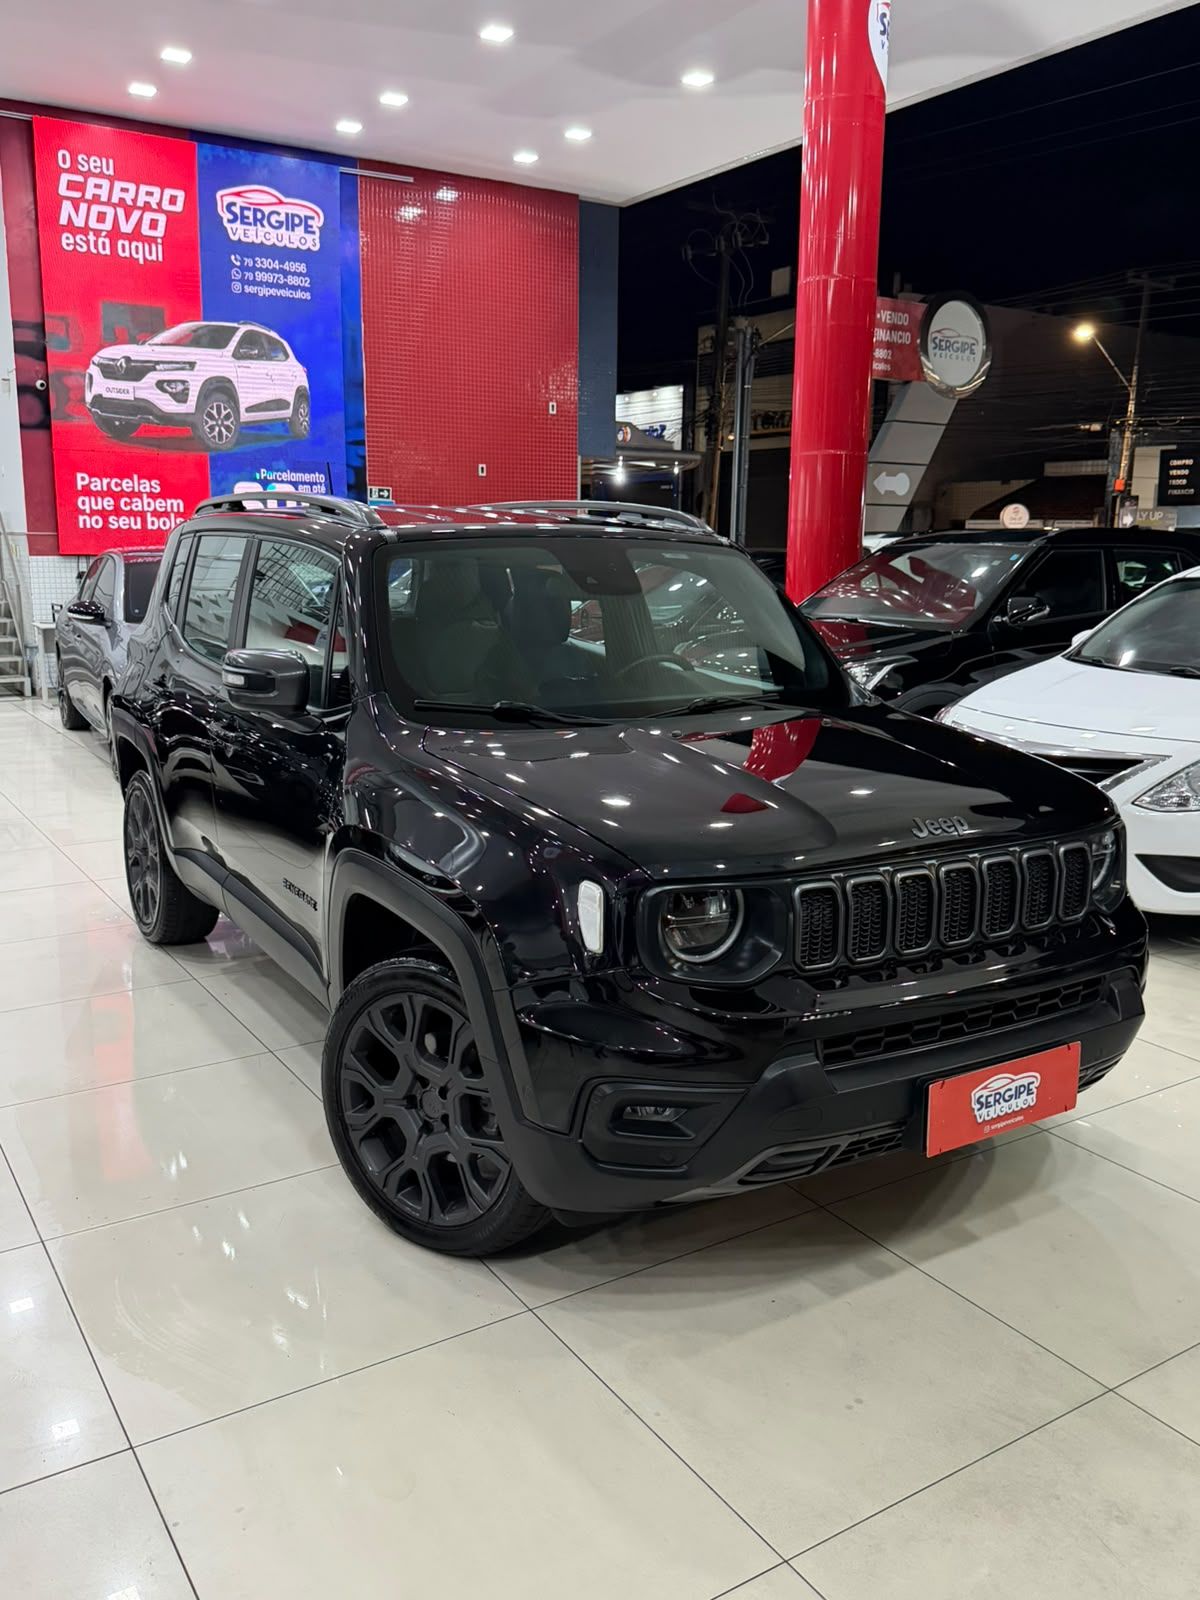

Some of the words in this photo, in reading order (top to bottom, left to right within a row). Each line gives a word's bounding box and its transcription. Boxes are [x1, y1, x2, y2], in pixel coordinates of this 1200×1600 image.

[77, 153, 115, 177] seu
[58, 172, 186, 213] CARRO
[59, 199, 168, 238] NOVO
[225, 201, 316, 235] SERGIPE
[230, 226, 317, 247] VEÍCULOS
[61, 230, 111, 256] está
[117, 238, 164, 265] aqui
[243, 257, 254, 268] 79
[255, 257, 307, 273] 3304-4956
[244, 271, 254, 281] 79
[255, 271, 310, 287] 99973-8802
[244, 285, 311, 300] sergipeveiculos
[881, 310, 909, 326] VENDO
[932, 337, 976, 355] SERGIPE
[76, 471, 161, 494] Parcelas
[260, 468, 326, 484] Parcelamento
[297, 484, 311, 493] em
[312, 483, 327, 495] até
[77, 494, 115, 514] que
[119, 493, 185, 514] cabem
[78, 514, 104, 530] no
[108, 515, 142, 531] seu
[146, 512, 190, 531] bols
[911, 815, 969, 839] Jeep
[976, 1081, 1035, 1112] SERGIPE
